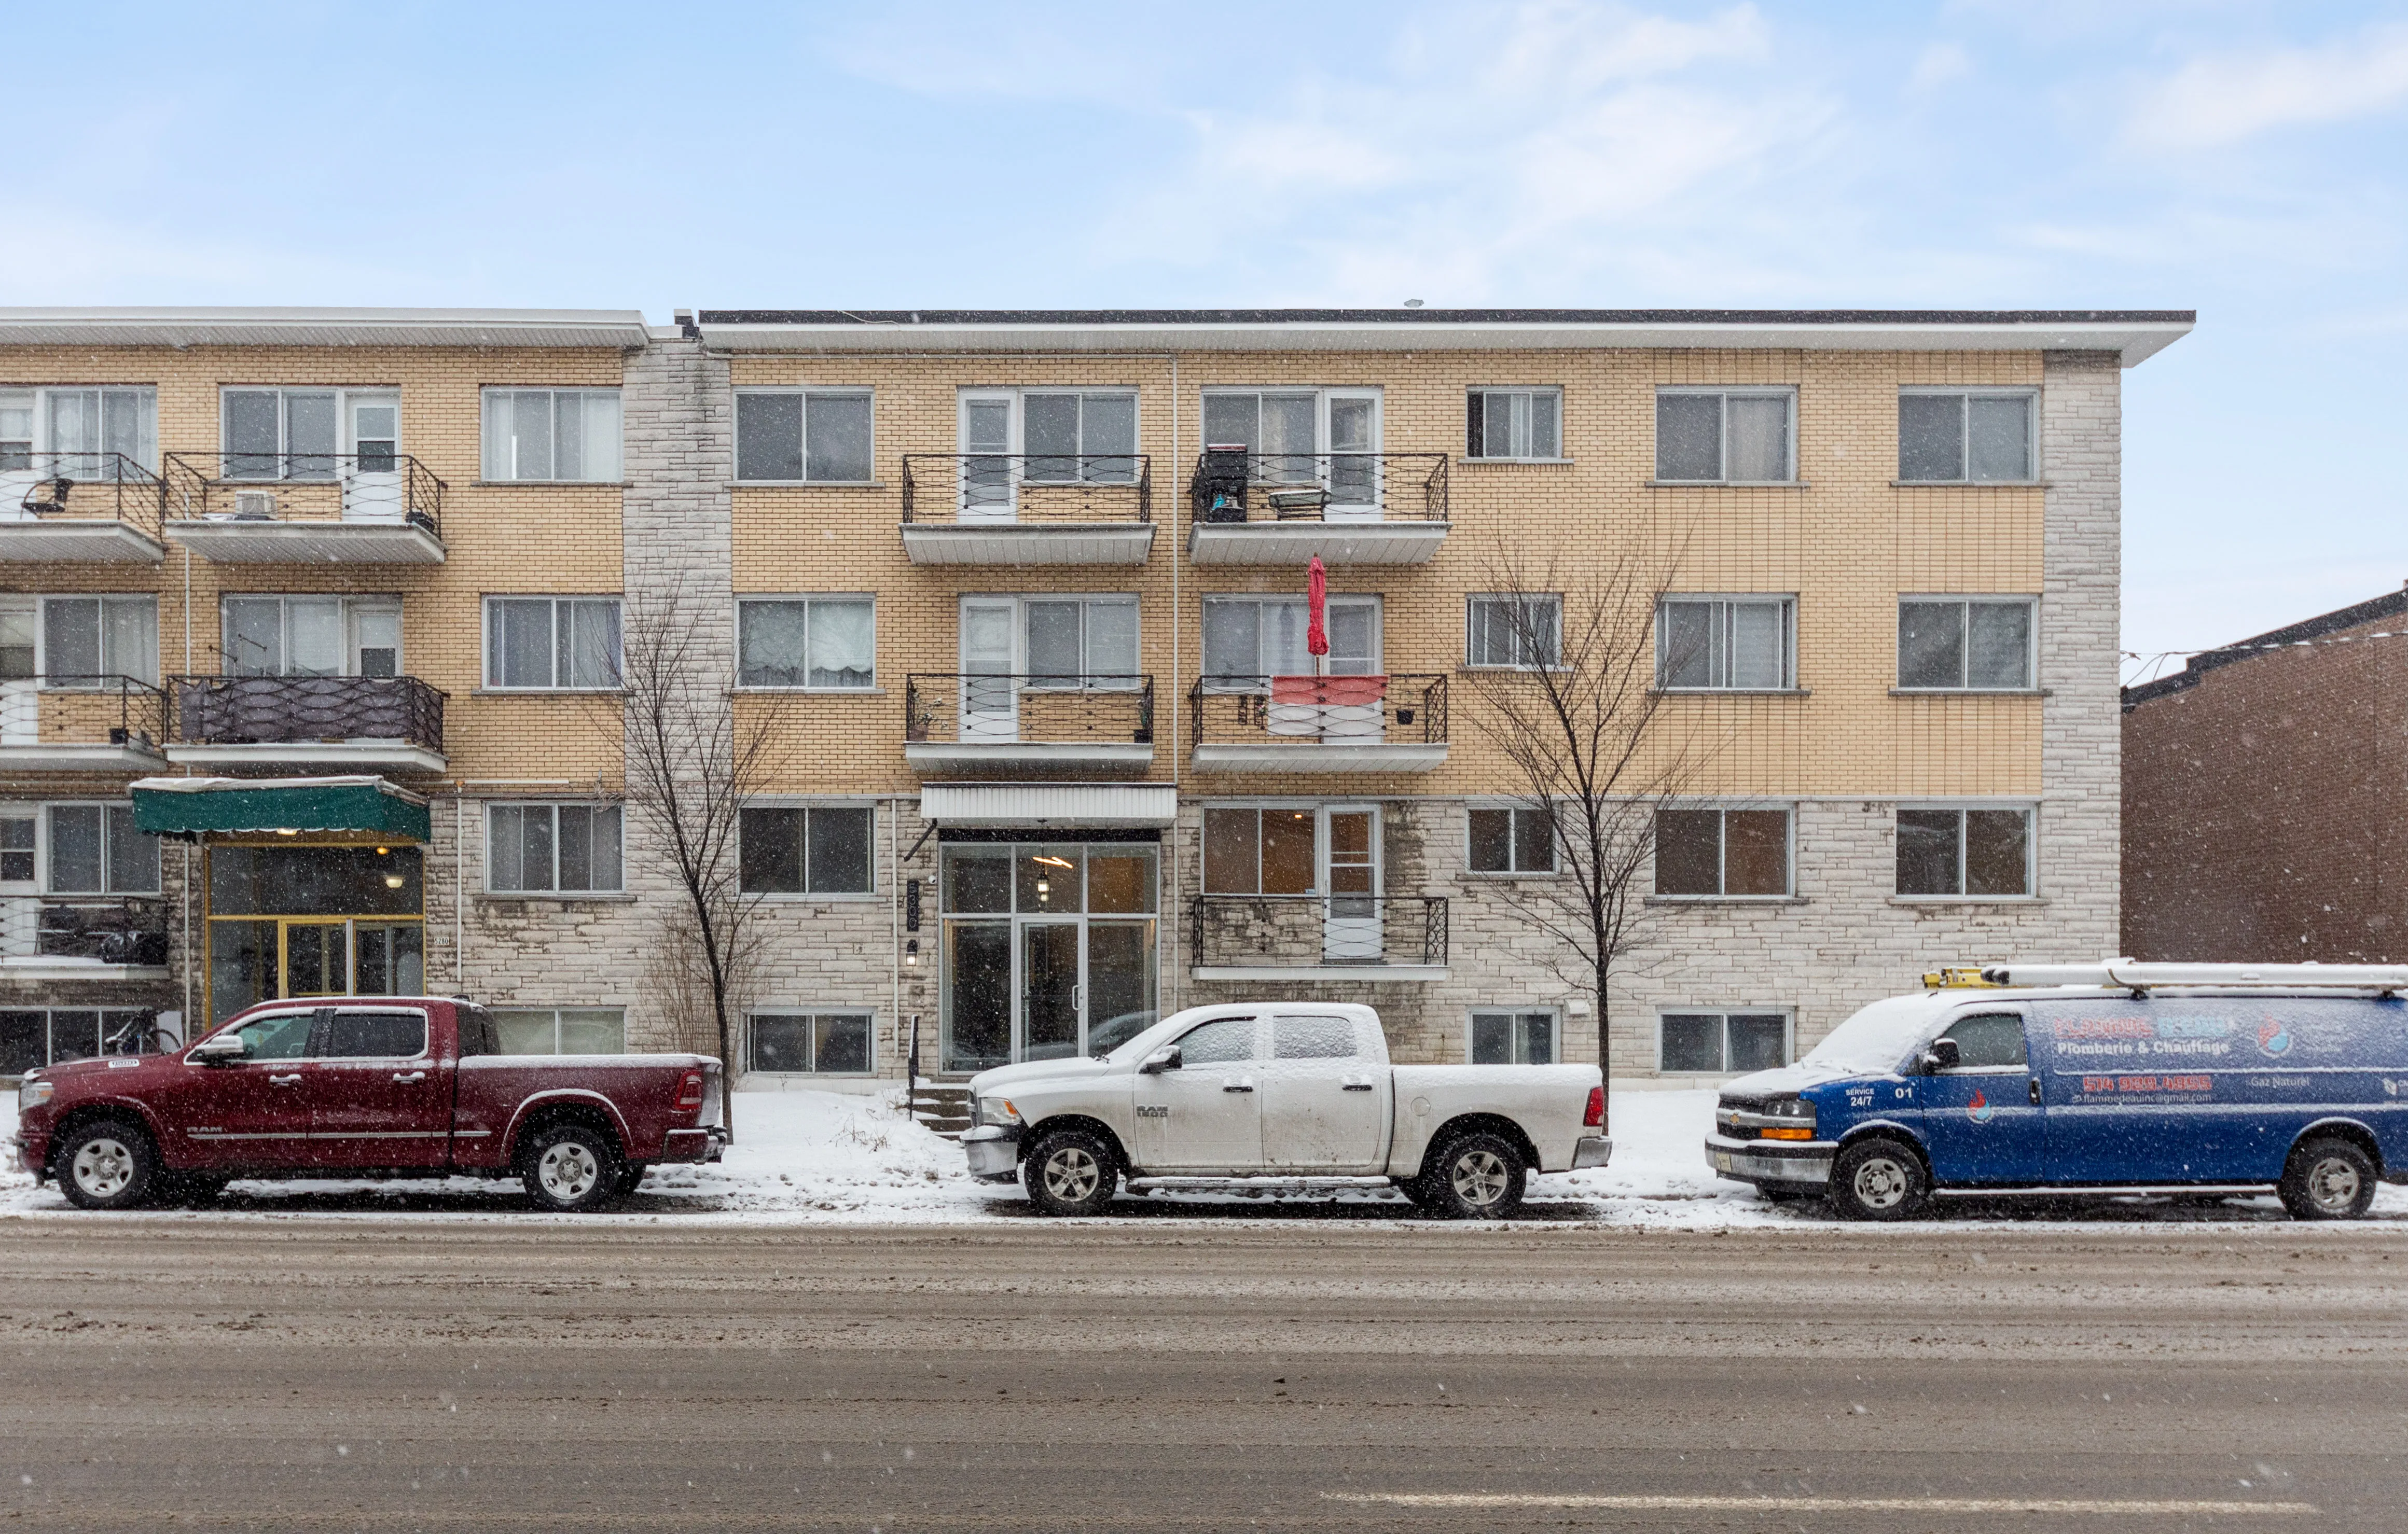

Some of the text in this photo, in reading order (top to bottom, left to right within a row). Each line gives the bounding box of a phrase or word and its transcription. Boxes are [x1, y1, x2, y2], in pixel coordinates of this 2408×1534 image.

[909, 883, 917, 928] 5300
[2057, 1040, 2230, 1055] Plomberie & Chauffage
[2083, 1076, 2114, 1092] 514
[2251, 1076, 2309, 1087] Gaz Naturel
[1895, 1087, 1912, 1098] 01
[1850, 1096, 1872, 1106] 24/7
